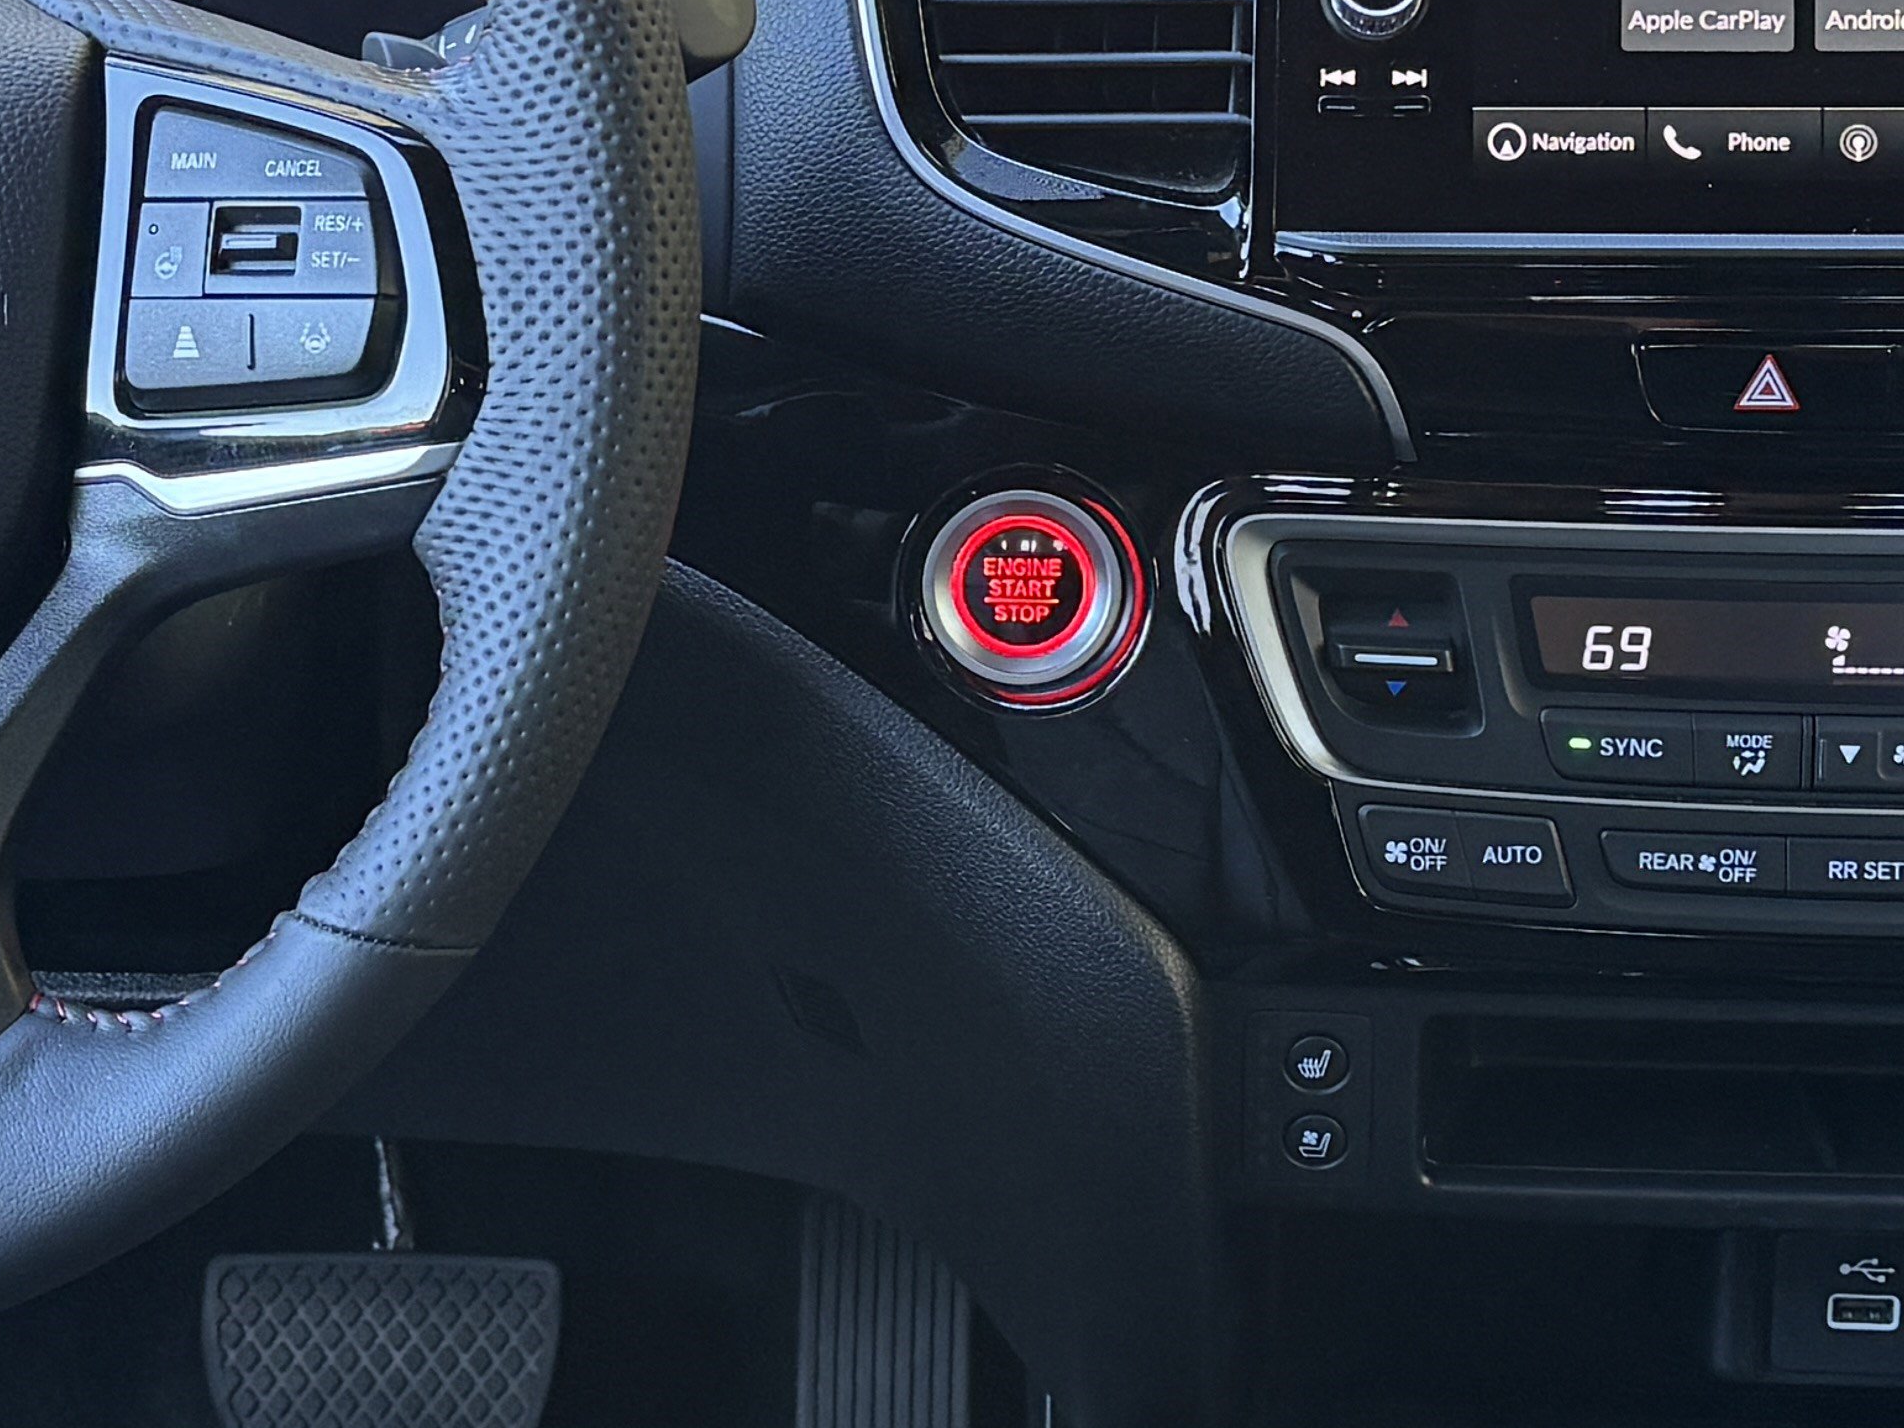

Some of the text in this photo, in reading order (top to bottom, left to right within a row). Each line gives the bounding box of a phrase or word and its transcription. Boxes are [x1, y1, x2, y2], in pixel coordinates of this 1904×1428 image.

[1628, 10, 1785, 33] Apple CarPlay
[1533, 132, 1634, 154] Navigation
[1728, 132, 1790, 151] Phone
[171, 152, 217, 170] MAIN
[265, 160, 323, 178] CANCEL
[314, 215, 365, 234] RES/+
[311, 252, 361, 269] SET/-
[984, 557, 1062, 577] ENGINE
[988, 579, 1055, 597] START
[994, 604, 1049, 623] STOP
[1582, 625, 1652, 672] 69
[1600, 738, 1662, 757] SYNC
[1727, 735, 1772, 748] MODE
[1410, 838, 1445, 855] ON/
[1483, 846, 1542, 863] AUTO
[1411, 854, 1447, 872] OFF
[1640, 852, 1693, 870] REAR
[1720, 849, 1756, 866] ON/
[1719, 865, 1756, 883] OFF
[1829, 861, 1857, 879] RR
